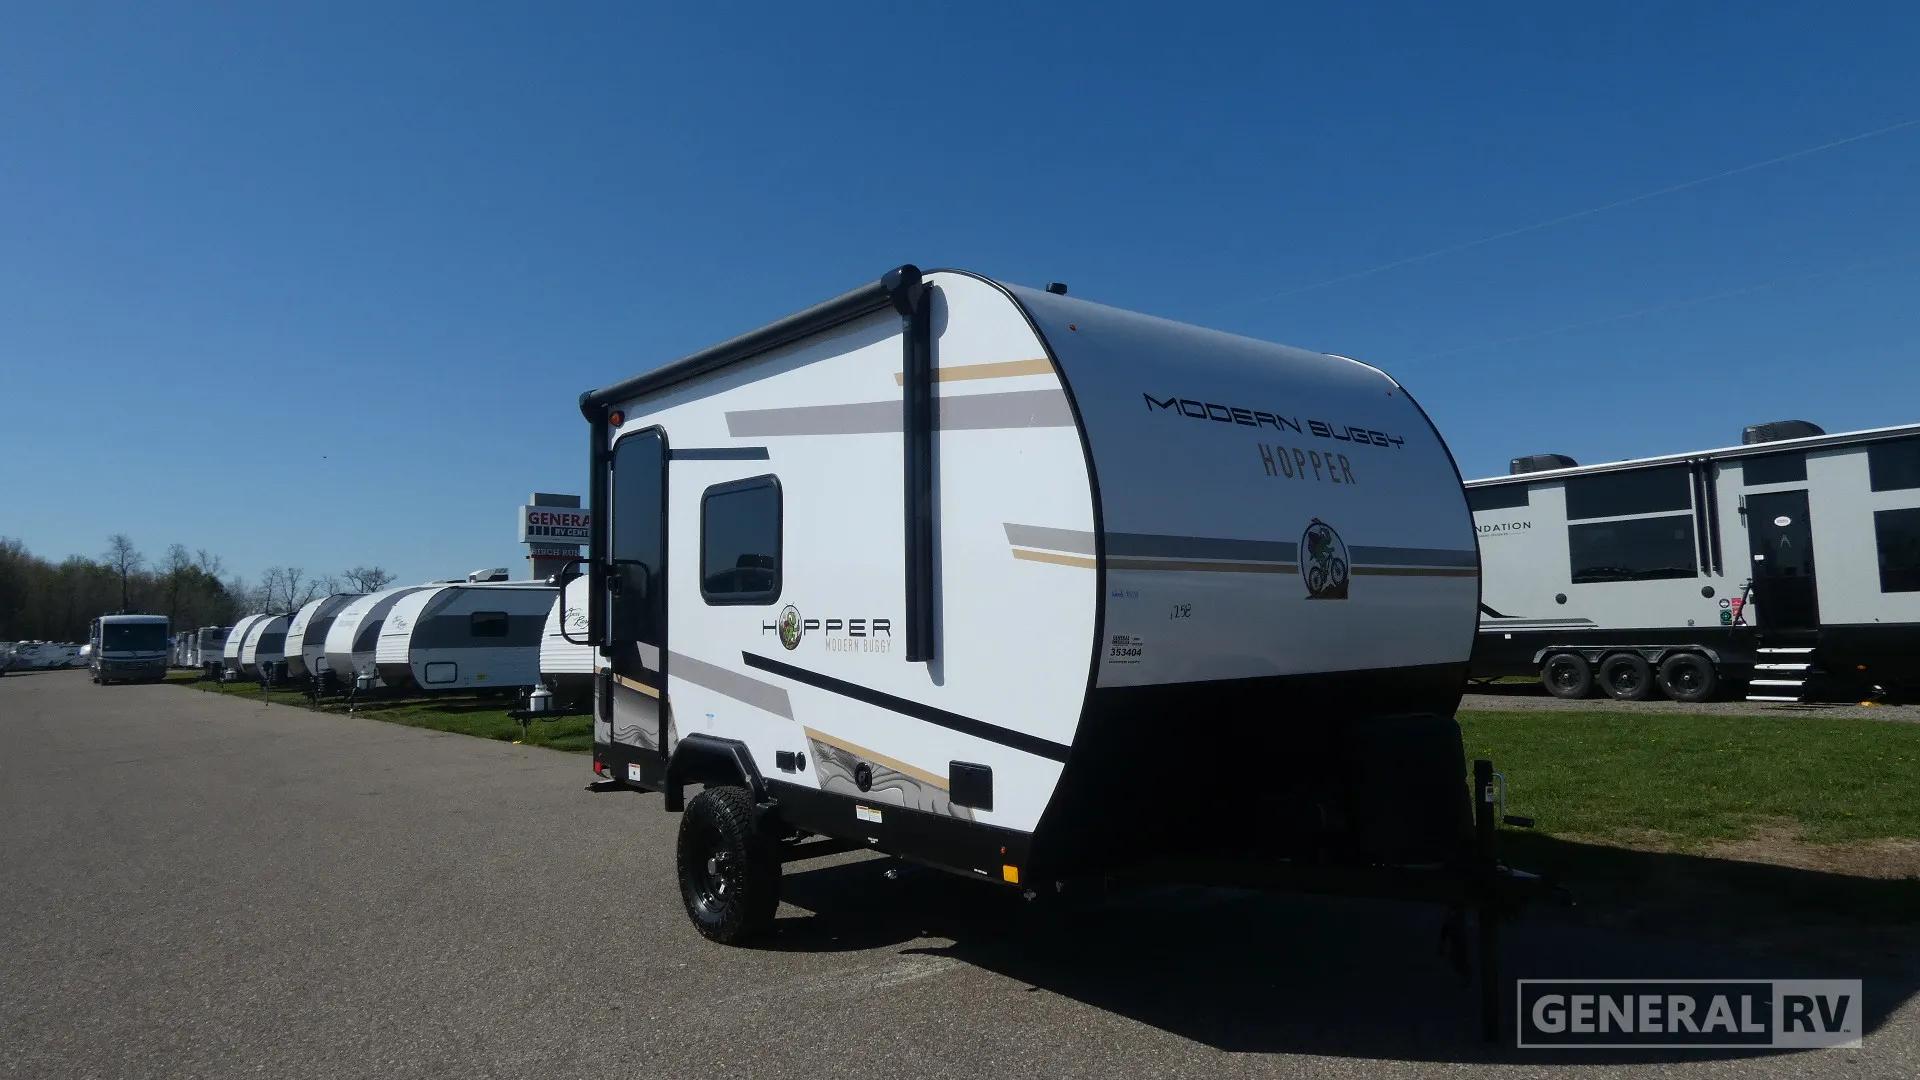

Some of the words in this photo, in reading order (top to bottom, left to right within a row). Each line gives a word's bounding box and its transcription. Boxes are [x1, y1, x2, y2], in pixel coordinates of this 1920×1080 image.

[1142, 392, 1303, 434] MODERN
[1307, 419, 1405, 450] BUGGY
[1258, 443, 1356, 485] HOPPER
[528, 511, 590, 527] GENERA
[1475, 521, 1531, 533] NDATION
[554, 527, 566, 536] RV
[567, 528, 590, 537] CENT
[825, 638, 859, 652] MODERN
[863, 639, 891, 654] BUGGY
[1110, 648, 1142, 657] 353404
